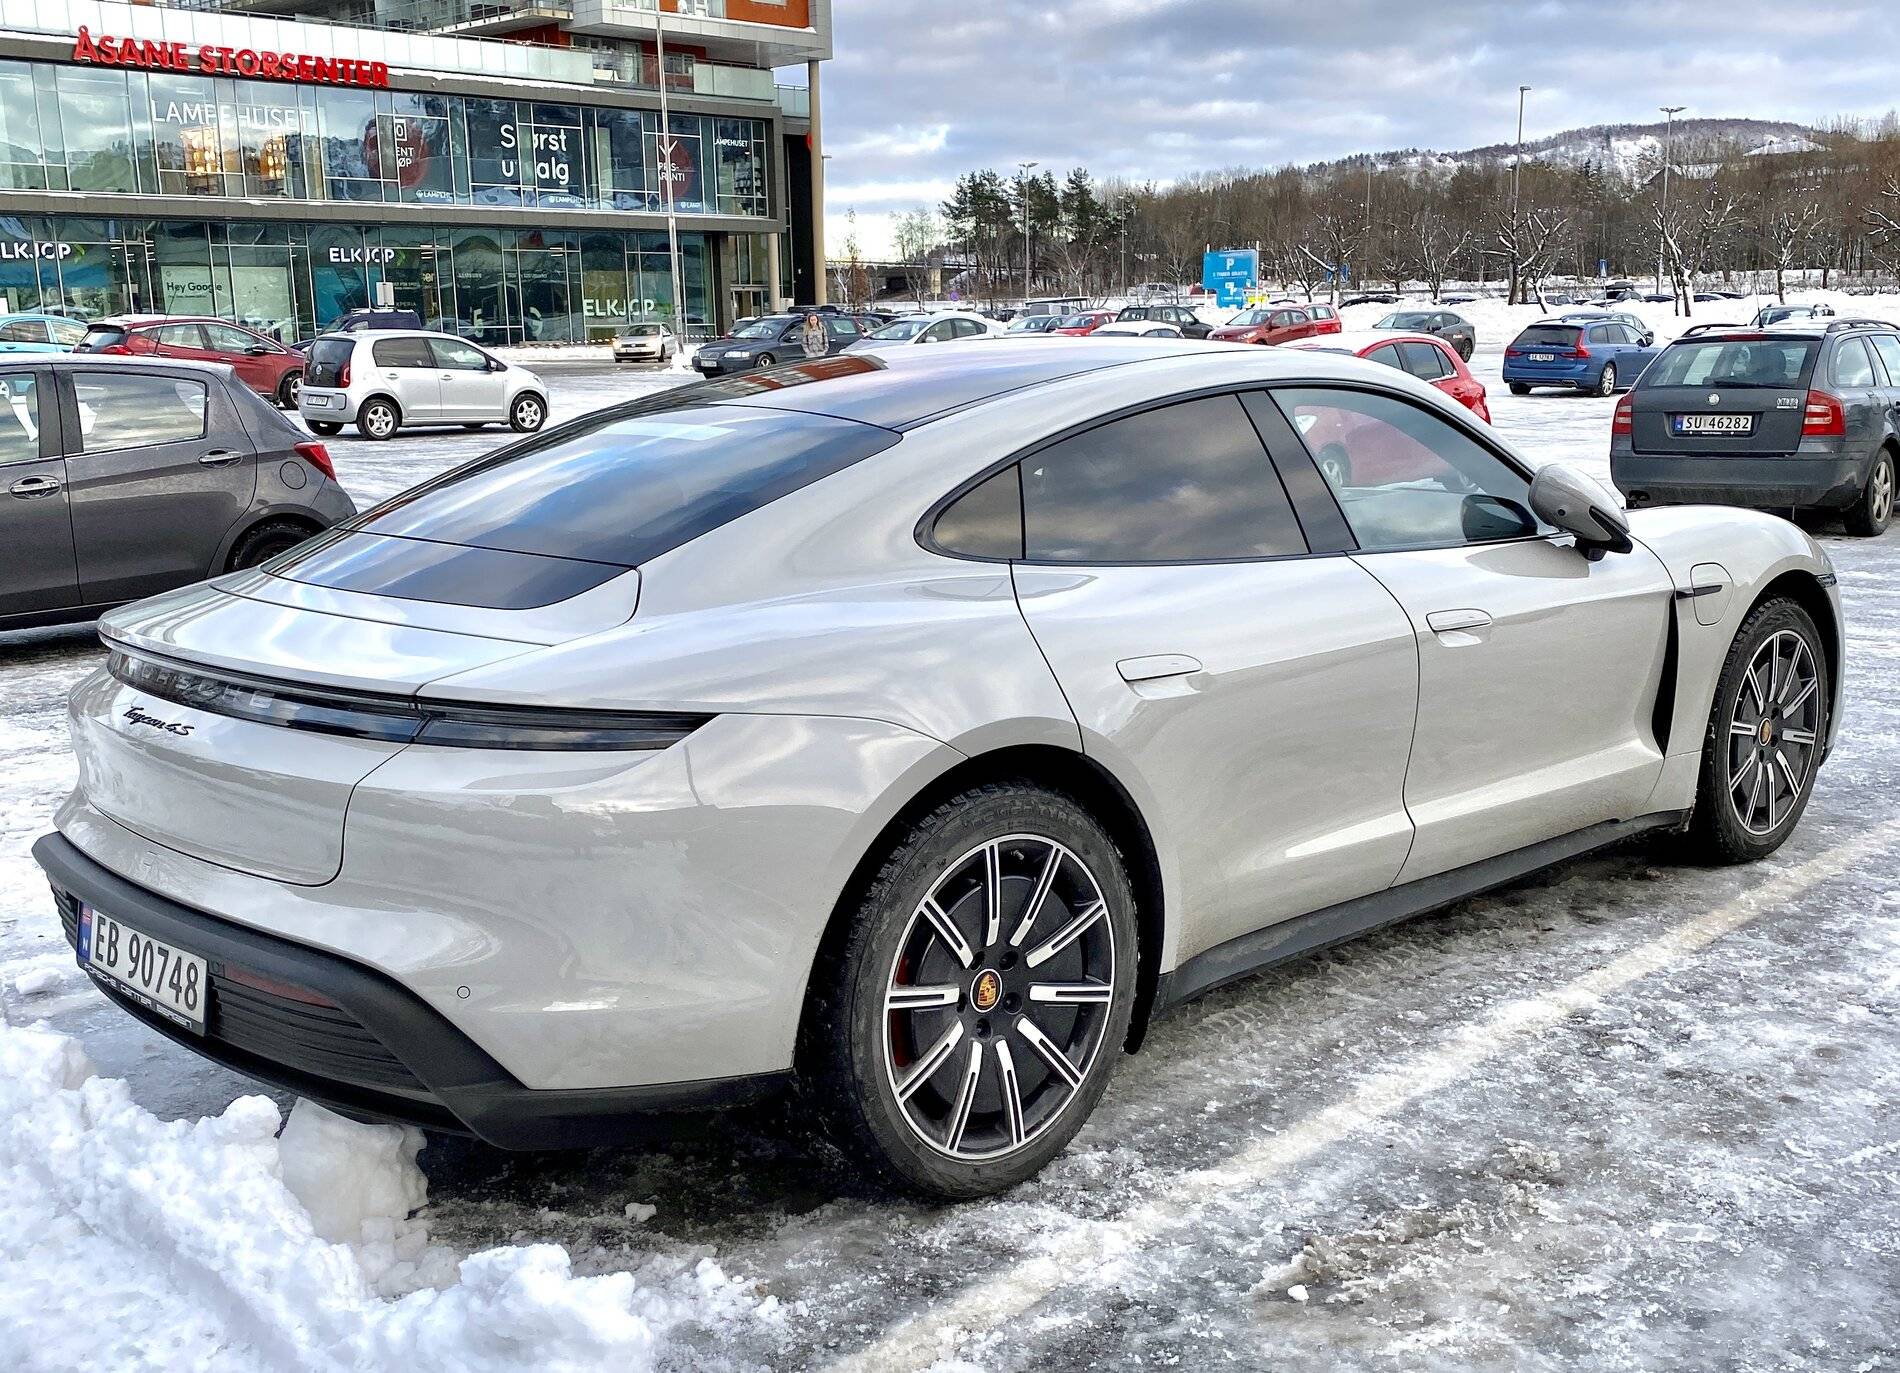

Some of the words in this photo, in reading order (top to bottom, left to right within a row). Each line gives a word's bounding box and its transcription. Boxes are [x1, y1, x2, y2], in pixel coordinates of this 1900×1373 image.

[73, 25, 190, 71] ÅSANE
[199, 45, 390, 88] STORSENTER
[150, 99, 312, 131] LAMPEHUSET
[500, 123, 567, 152] Srst
[501, 156, 569, 186] ualg
[166, 281, 186, 294] Hey
[1685, 416, 1702, 429] SU
[1708, 416, 1750, 430] 46282
[94, 914, 120, 968] EB
[127, 932, 200, 1012] 90748
